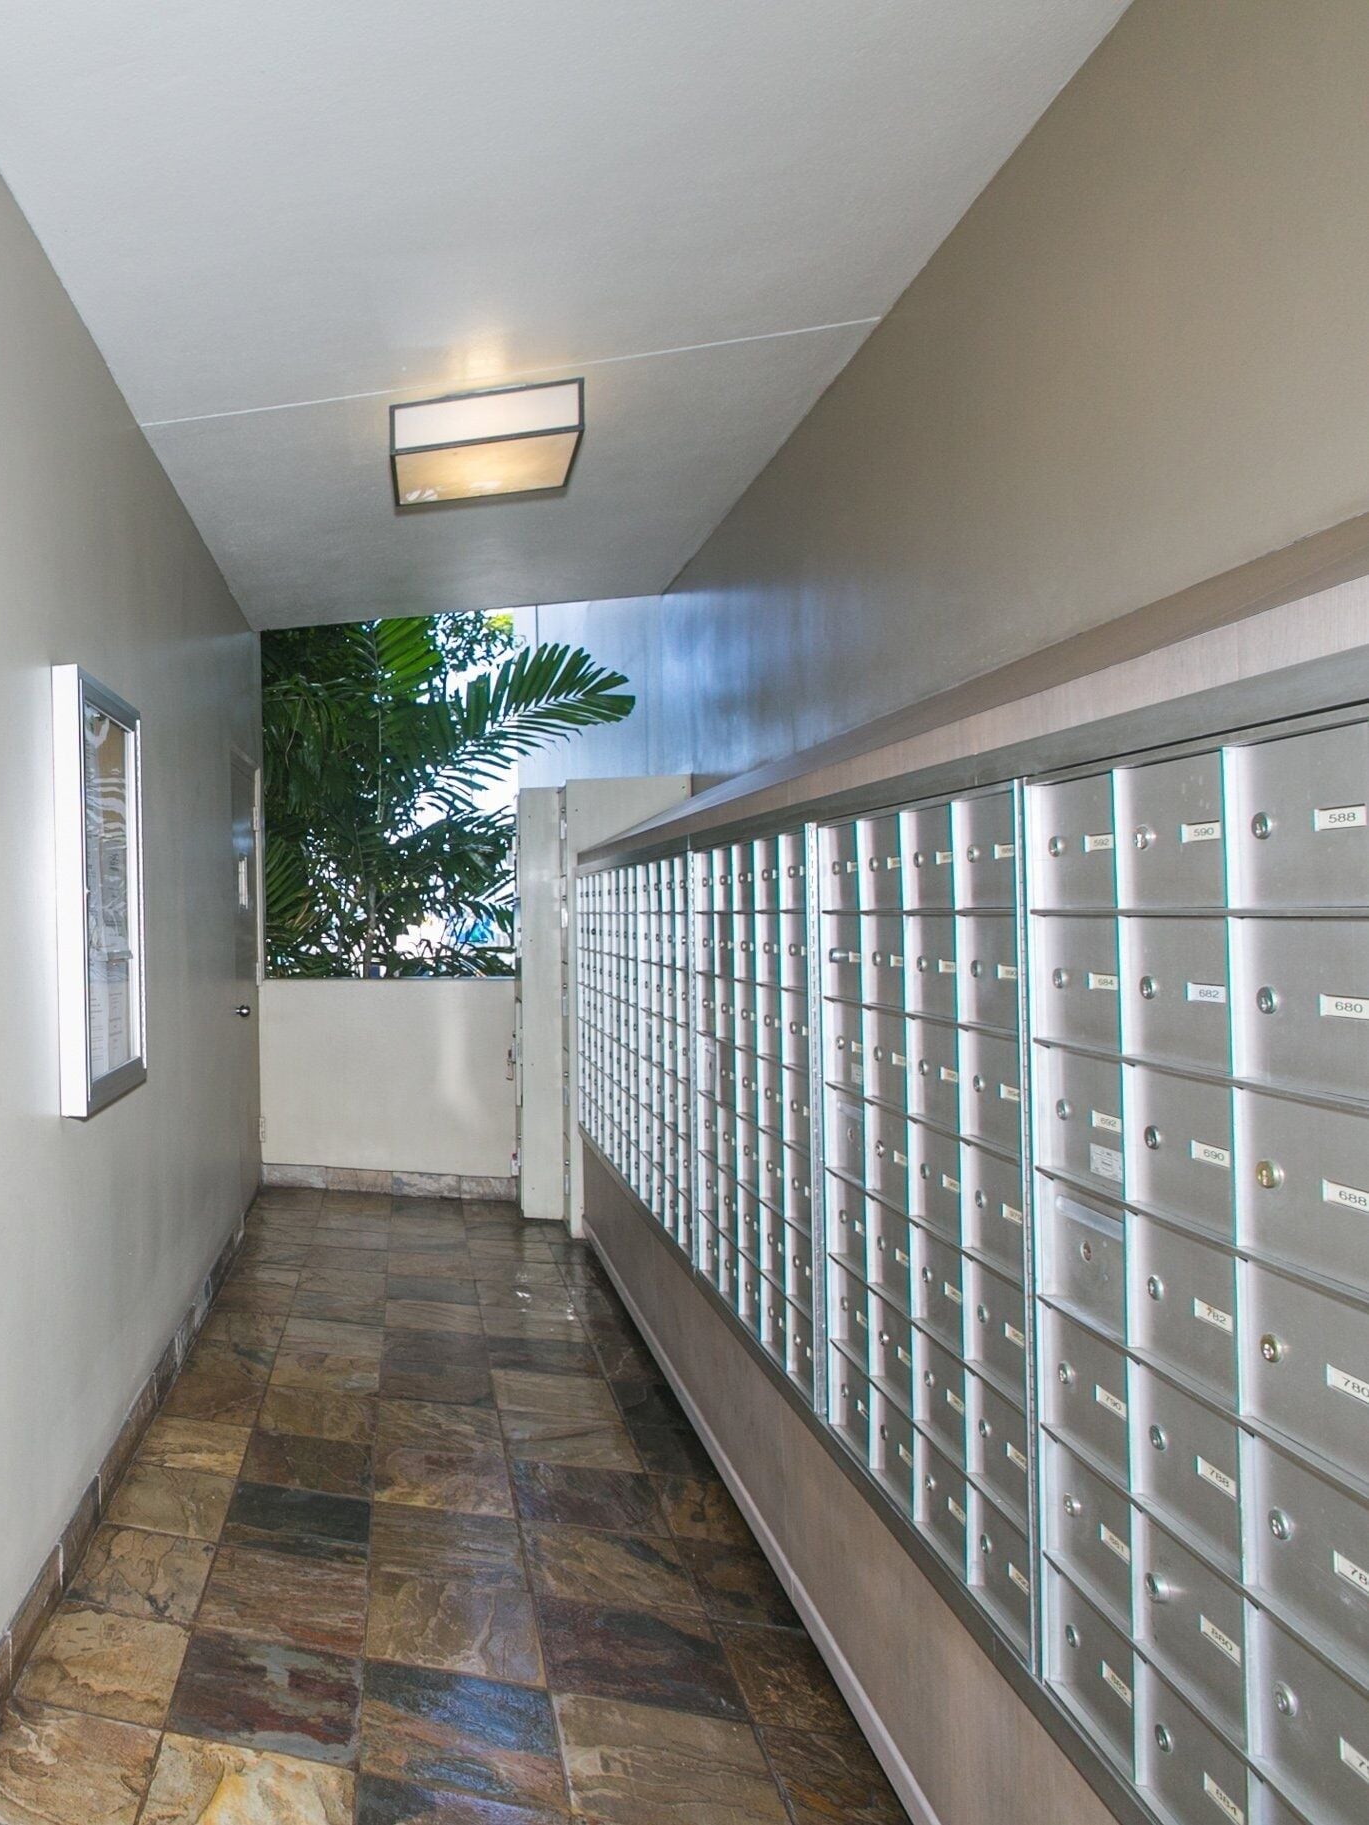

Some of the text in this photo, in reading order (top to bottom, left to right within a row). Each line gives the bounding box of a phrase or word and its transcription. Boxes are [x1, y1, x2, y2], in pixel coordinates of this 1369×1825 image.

[1329, 811, 1357, 824] 588
[1194, 826, 1215, 837] 590
[1094, 838, 1109, 846] 592
[1098, 978, 1114, 988] 684
[1199, 989, 1219, 999] 682
[1335, 1000, 1364, 1013] 680
[1100, 1117, 1117, 1127] 692
[1203, 1149, 1224, 1161] 690
[1339, 1190, 1367, 1206] 688
[1206, 1306, 1226, 1325] 782
[1105, 1394, 1121, 1411] 790
[1208, 1467, 1229, 1488] 788
[1211, 1627, 1233, 1651] 880
[1215, 1788, 1237, 1816] 884
